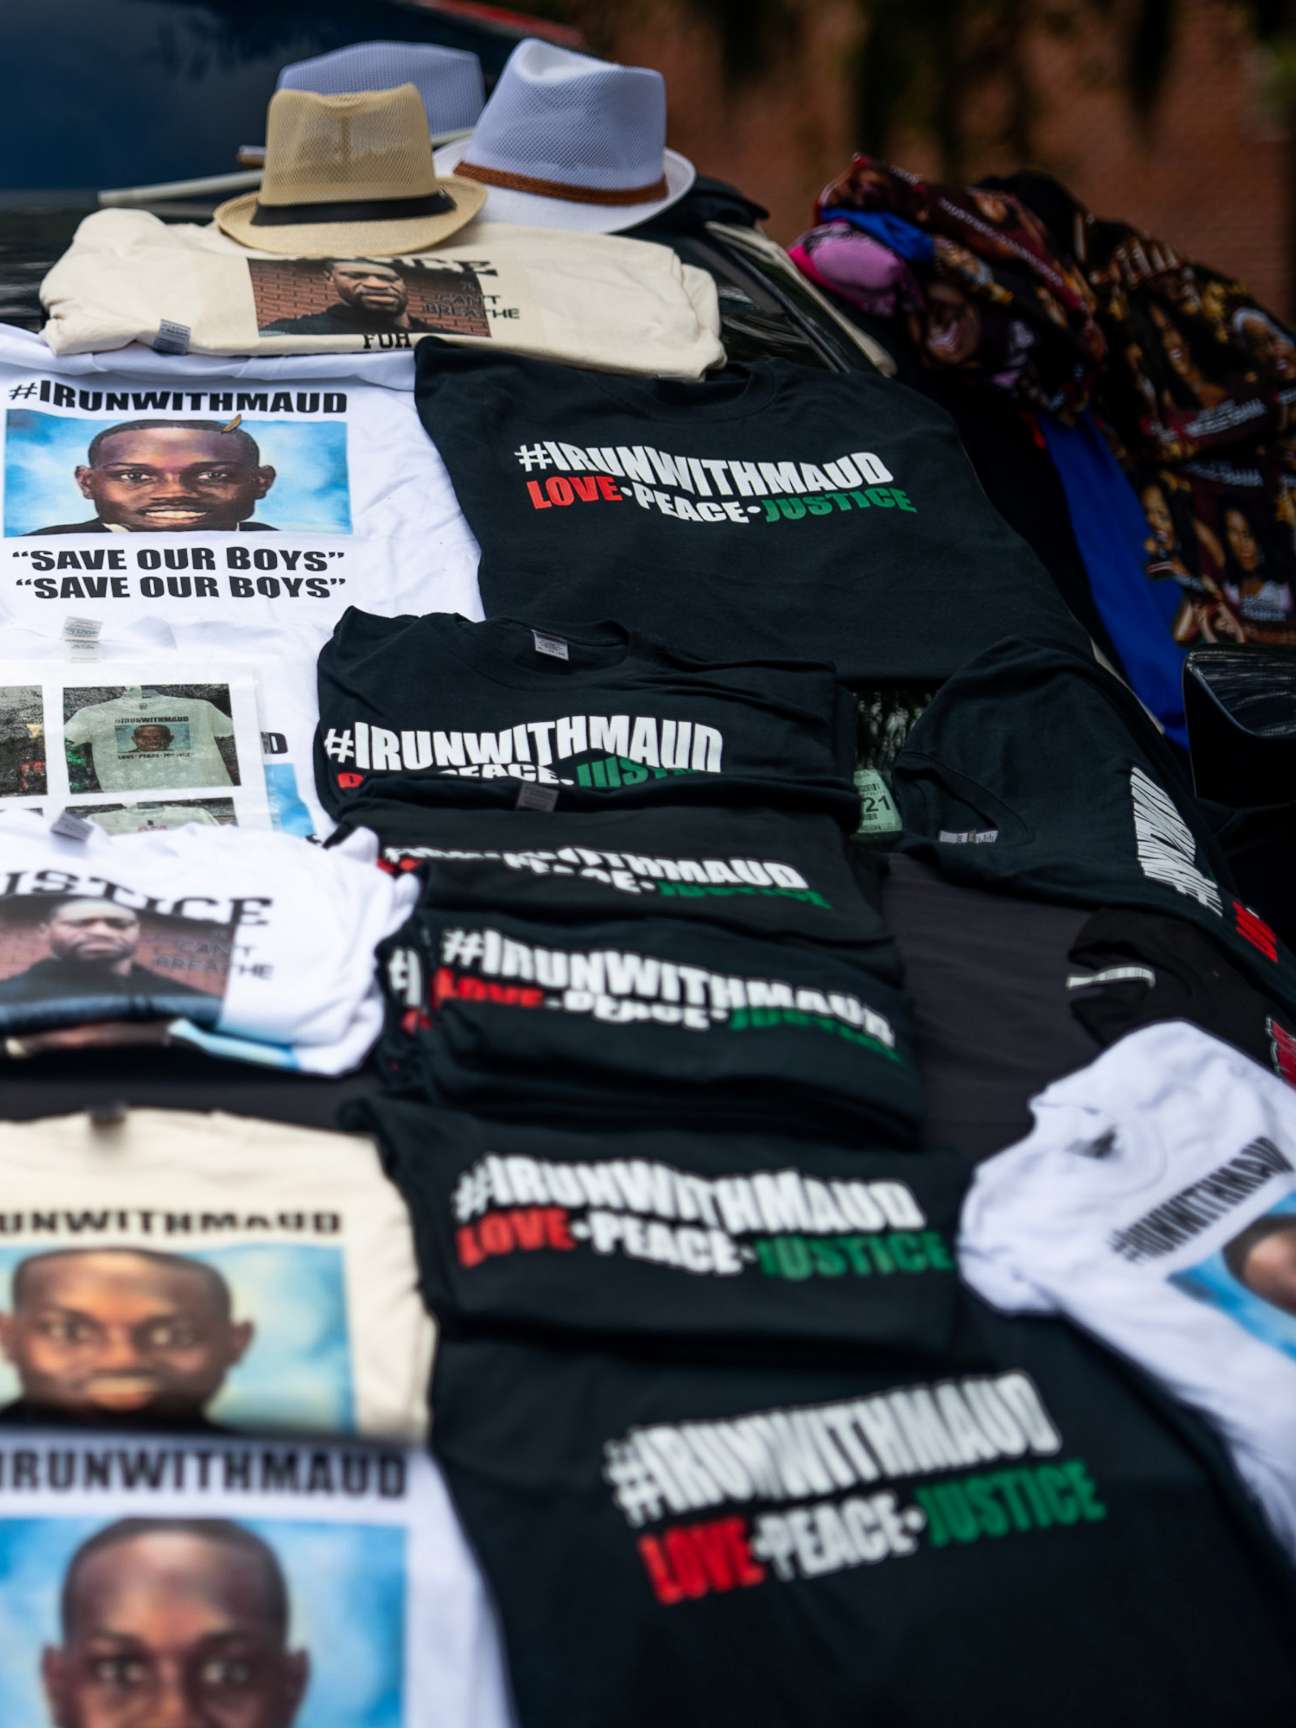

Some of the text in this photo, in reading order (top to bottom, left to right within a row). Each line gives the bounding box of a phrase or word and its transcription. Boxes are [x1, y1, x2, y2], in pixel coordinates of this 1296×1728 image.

[9, 380, 347, 415] #IRUNWITHMAUD
[514, 441, 894, 498] #IRUNWITHMAUD
[12, 547, 345, 572] “SAVE OUR BOYS”
[16, 576, 346, 600] “SAVE OUR BOYS”
[324, 715, 723, 774] #IRUNWITHMAUD
[442, 928, 895, 1048] #IRUNWITHMAUD
[452, 1154, 926, 1234] #IRUNWITHMAUD
[603, 1369, 1063, 1527] #IRUNWITHMAUD
